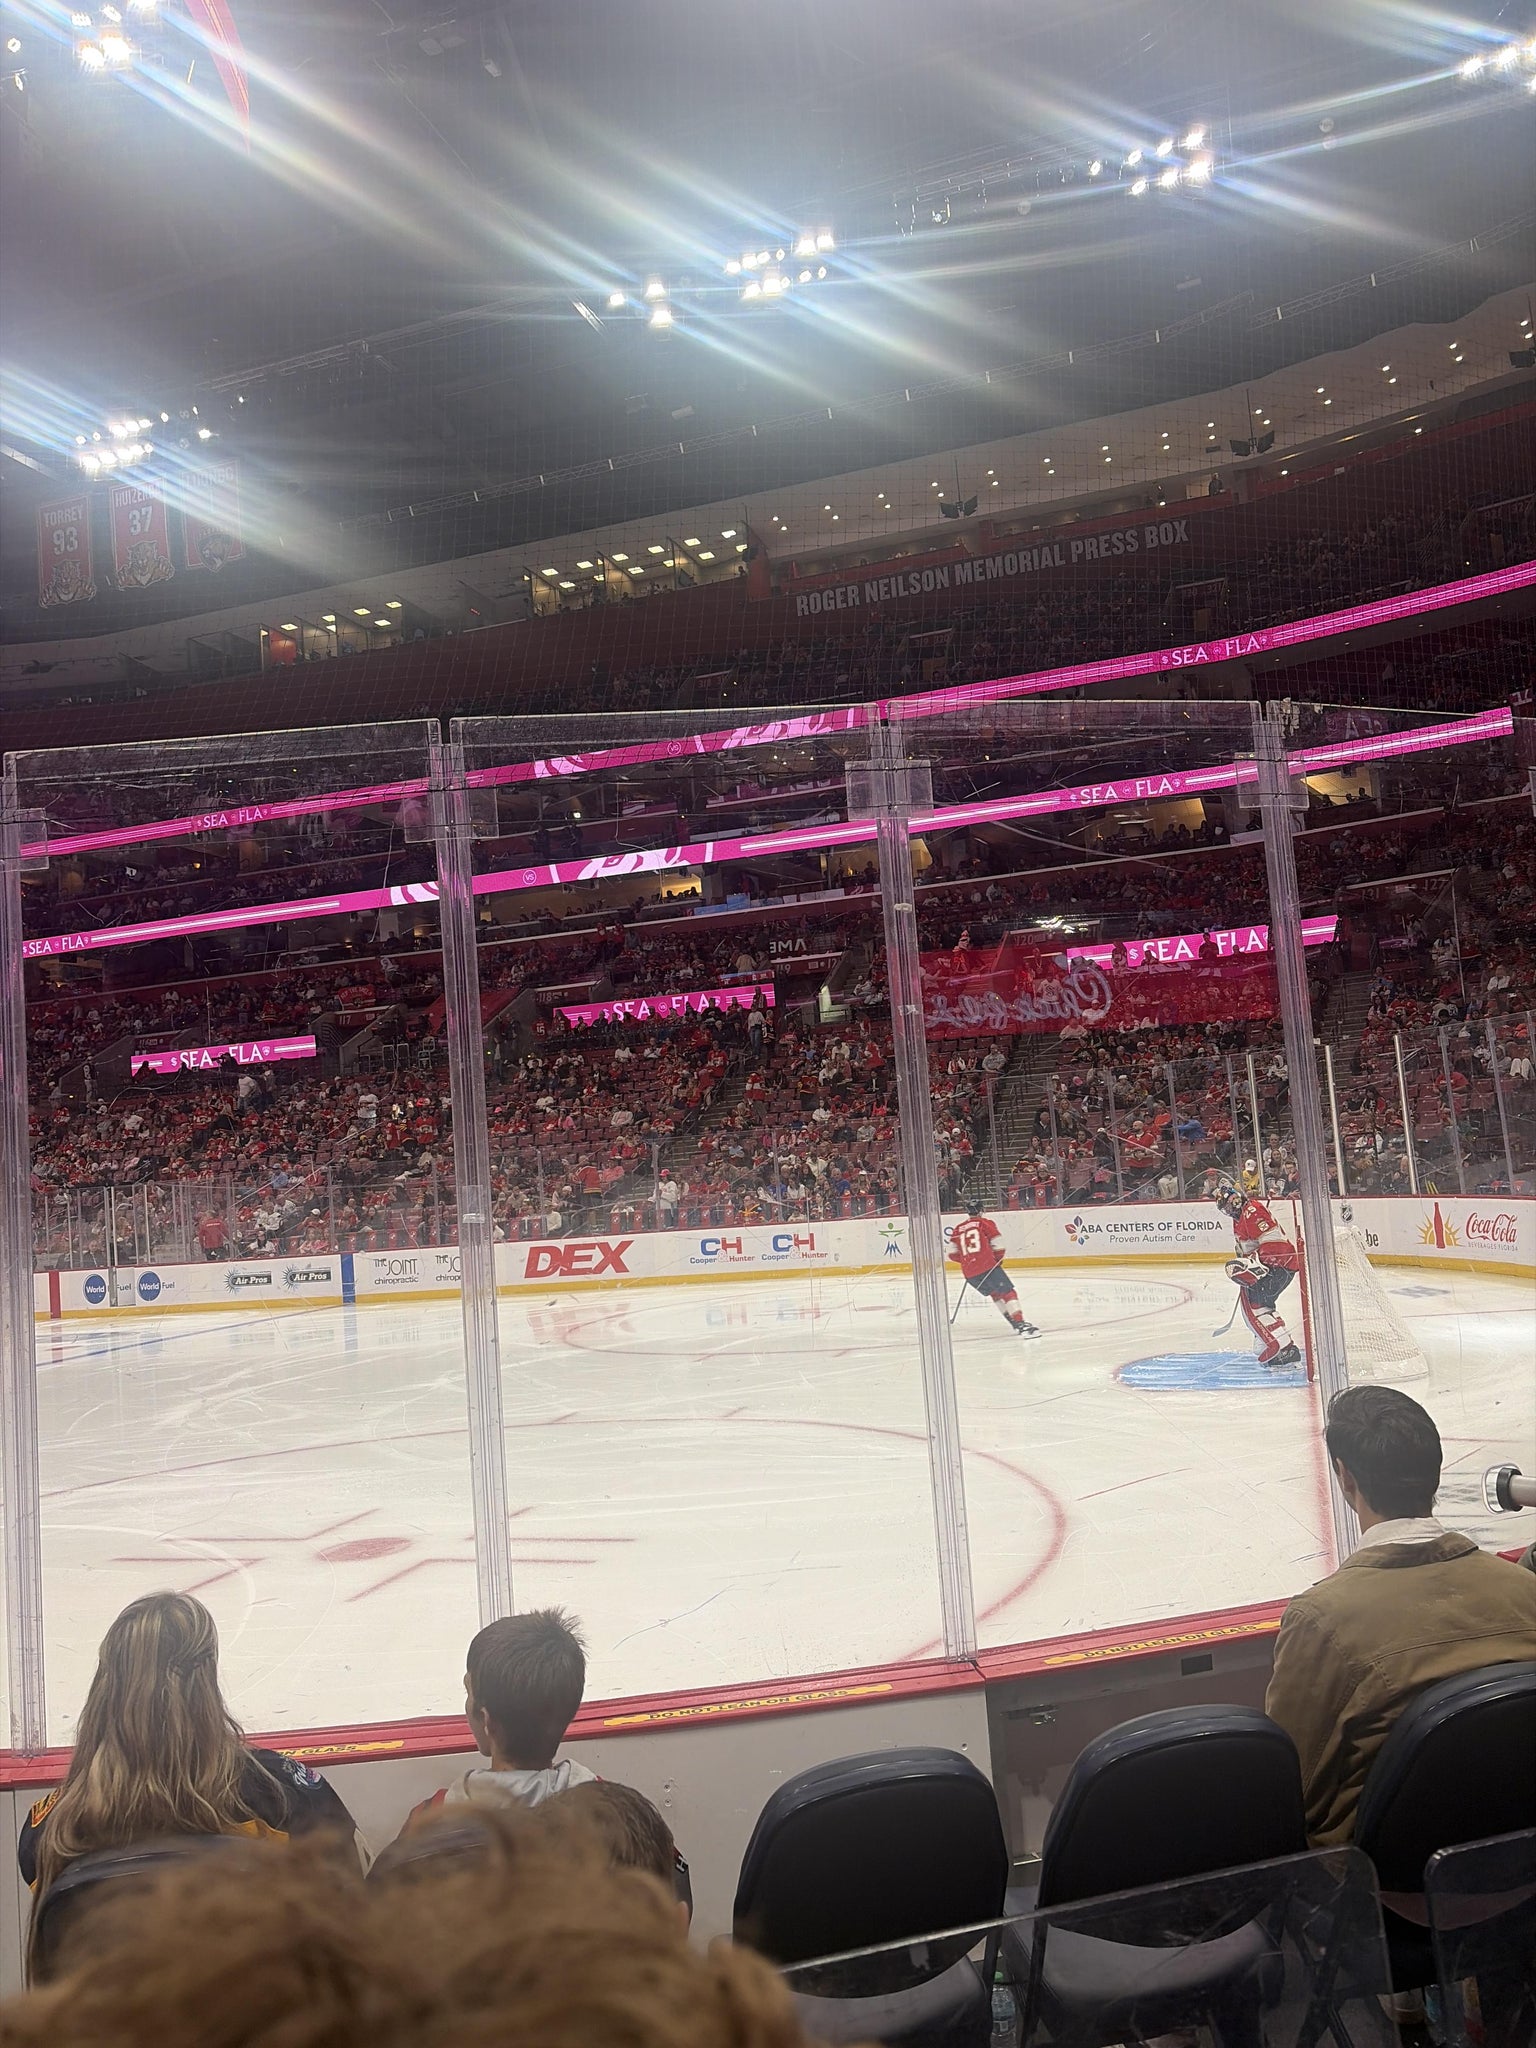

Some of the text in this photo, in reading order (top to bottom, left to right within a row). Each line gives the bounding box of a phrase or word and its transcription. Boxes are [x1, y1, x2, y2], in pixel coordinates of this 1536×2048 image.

[43, 504, 83, 527] TORREY
[128, 506, 152, 536] 37
[53, 526, 78, 555] 93
[796, 519, 1189, 617] ROGER NEILSON MEMORIAL PRESS BOX
[1171, 635, 1260, 665] SEA FLA
[1080, 777, 1173, 804] SEA FLA
[203, 807, 263, 828] SEA FLA
[29, 935, 85, 955] SEA FLA
[1142, 929, 1265, 961] SEA FLA
[612, 999, 652, 1021] SEA
[671, 993, 710, 1015] FLA
[339, 1015, 351, 1025] 117
[179, 1043, 264, 1068] SEA FLA
[1080, 1221, 1223, 1233] ABA CENTERS OF FLORIDA
[1109, 1232, 1196, 1243] Proven Autism Care
[1465, 1212, 1518, 1243] Coca-Cola
[700, 1236, 743, 1256] CH
[771, 1232, 815, 1253] CH
[960, 1229, 981, 1256] 13
[1468, 1241, 1497, 1250] BEVERAGES
[524, 1240, 635, 1279] DEX
[689, 1256, 717, 1265] Cooper
[729, 1254, 756, 1262] Hunter
[761, 1253, 789, 1261] Cooper
[801, 1251, 828, 1259] Hunter
[139, 1281, 176, 1291] World Fuel
[235, 1275, 268, 1285] Air Pros
[293, 1271, 328, 1281] Air Pros
[374, 1275, 419, 1285] chiropractic
[85, 1286, 105, 1294] World
[1109, 1643, 1141, 1653] NOT
[1144, 1636, 1182, 1648] LEAN
[1184, 1632, 1207, 1640] ON
[1209, 1625, 1258, 1638] GLASS
[649, 1690, 849, 1719] DO NOT LEAN ON GLASS
[301, 1745, 358, 1754] GLASS
